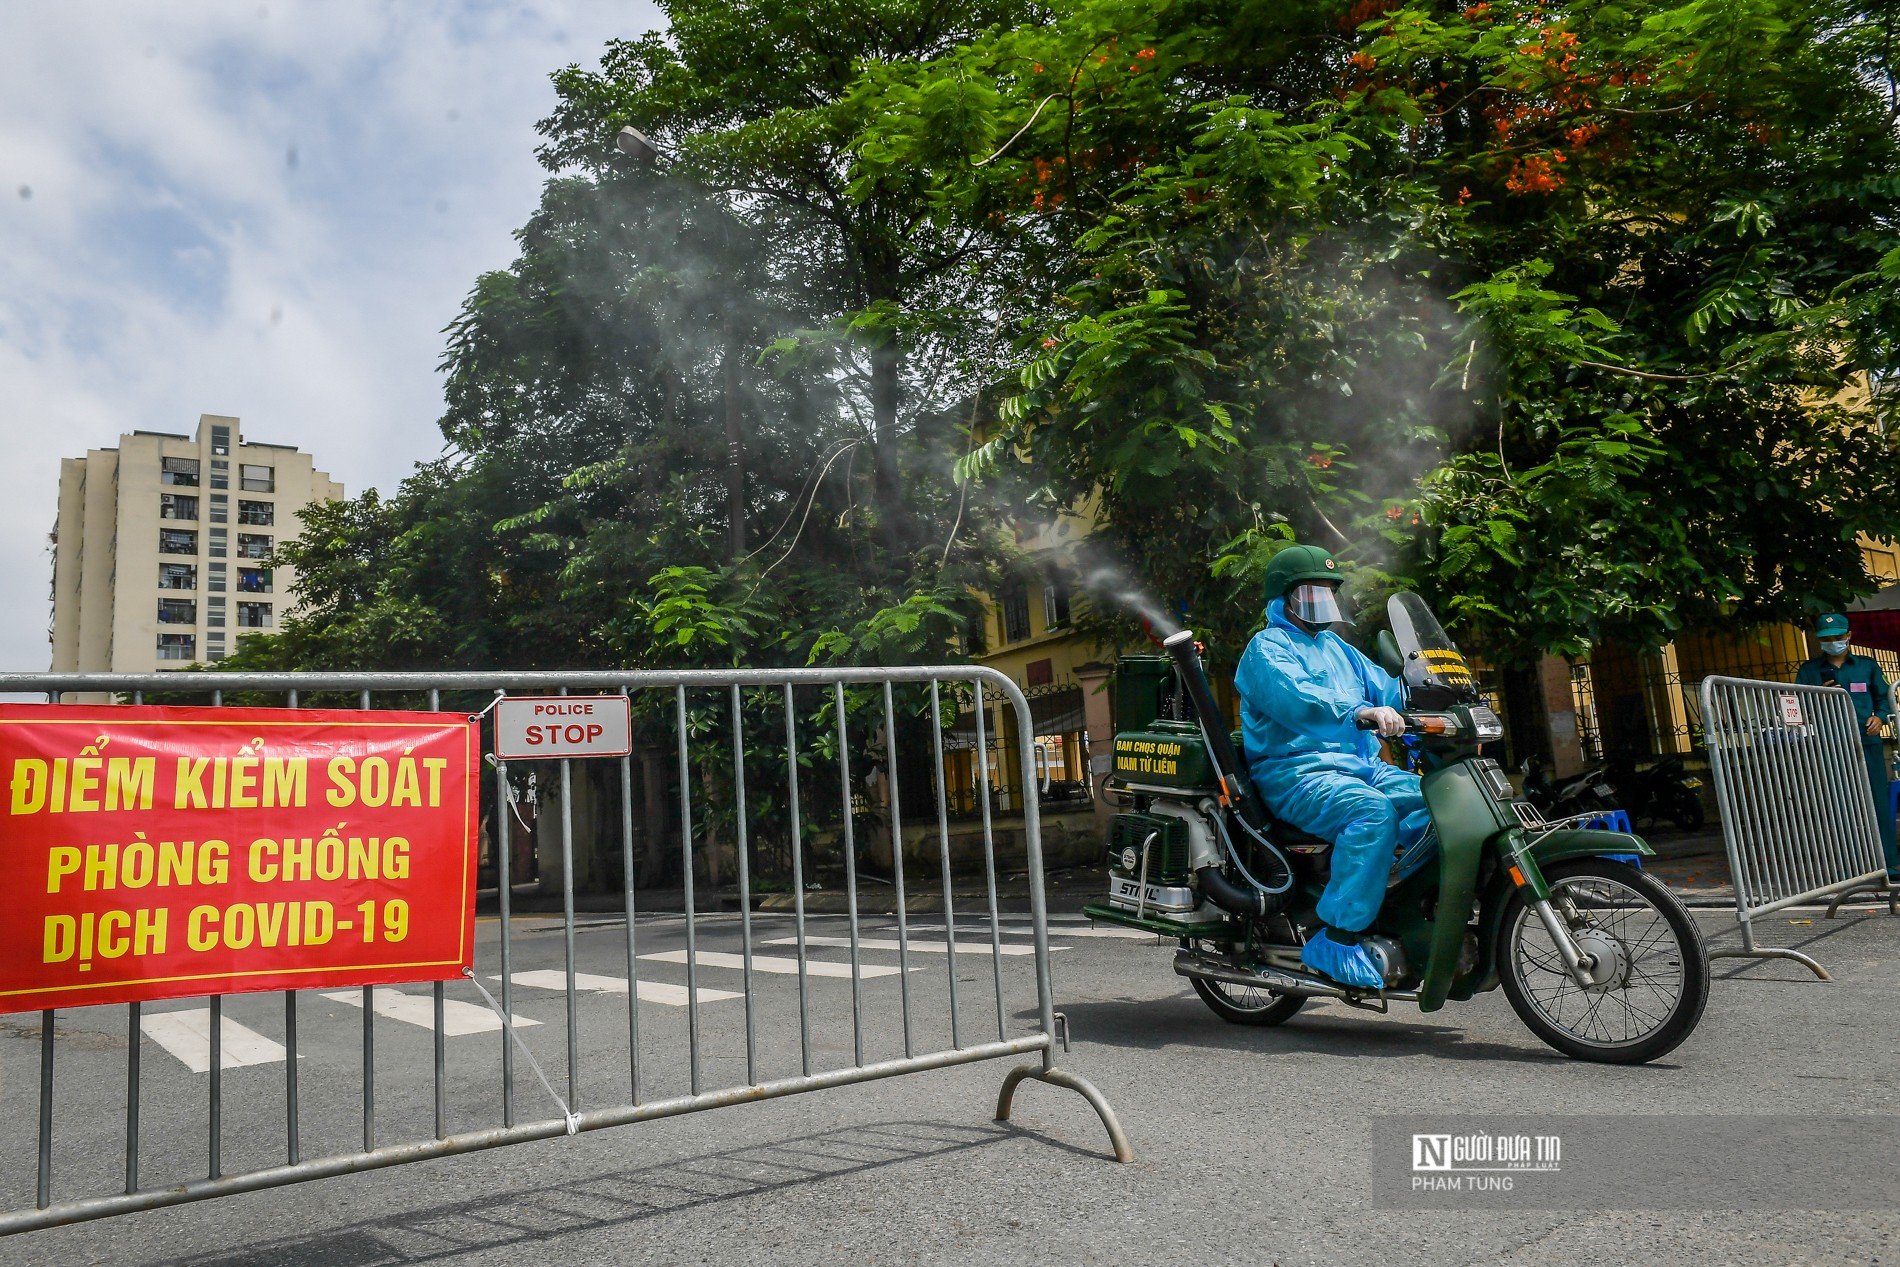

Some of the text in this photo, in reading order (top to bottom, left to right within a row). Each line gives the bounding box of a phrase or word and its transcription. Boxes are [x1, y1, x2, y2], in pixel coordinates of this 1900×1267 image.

[534, 704, 594, 716] POLICE
[525, 723, 604, 745] STOP
[1116, 740, 1181, 757] BAN CHQS QUẬN
[10, 735, 448, 815] ĐIỂM KIỂM SOÁT
[1117, 756, 1138, 771] NAM
[1153, 757, 1177, 775] LIÊM
[46, 822, 410, 894] PHÒNG CHỐNG
[43, 898, 409, 972] DỊCH COVID-19
